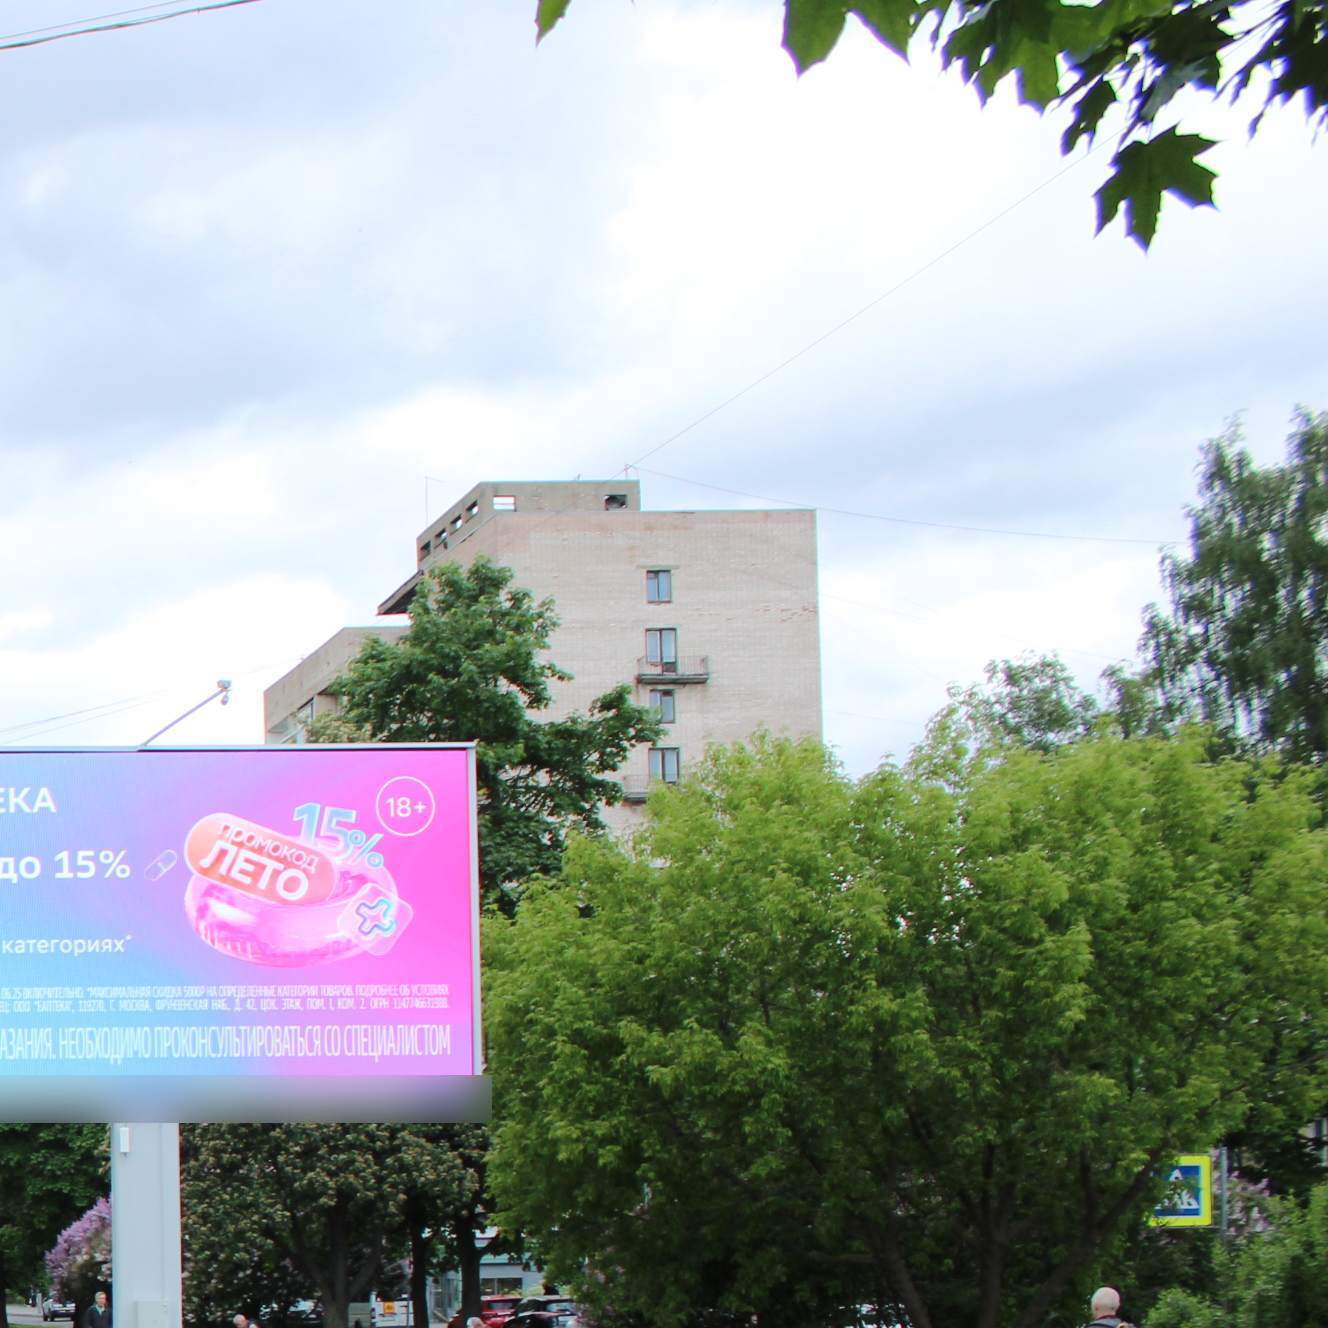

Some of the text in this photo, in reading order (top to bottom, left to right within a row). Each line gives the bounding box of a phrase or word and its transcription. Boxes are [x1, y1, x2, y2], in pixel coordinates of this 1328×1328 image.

[385, 797, 426, 817] 18+
[293, 801, 384, 868] 15%
[53, 849, 131, 879] 15%
[199, 840, 309, 901] ЛЕТО
[59, 1026, 152, 1064] НЕОБХОДИМО
[155, 1024, 321, 1059] ПРОКОНСУЛЬТИРОВАТЬСЯ
[325, 1025, 341, 1057] СО
[344, 1024, 451, 1063] СПЕЦИАЛИСТОМ
